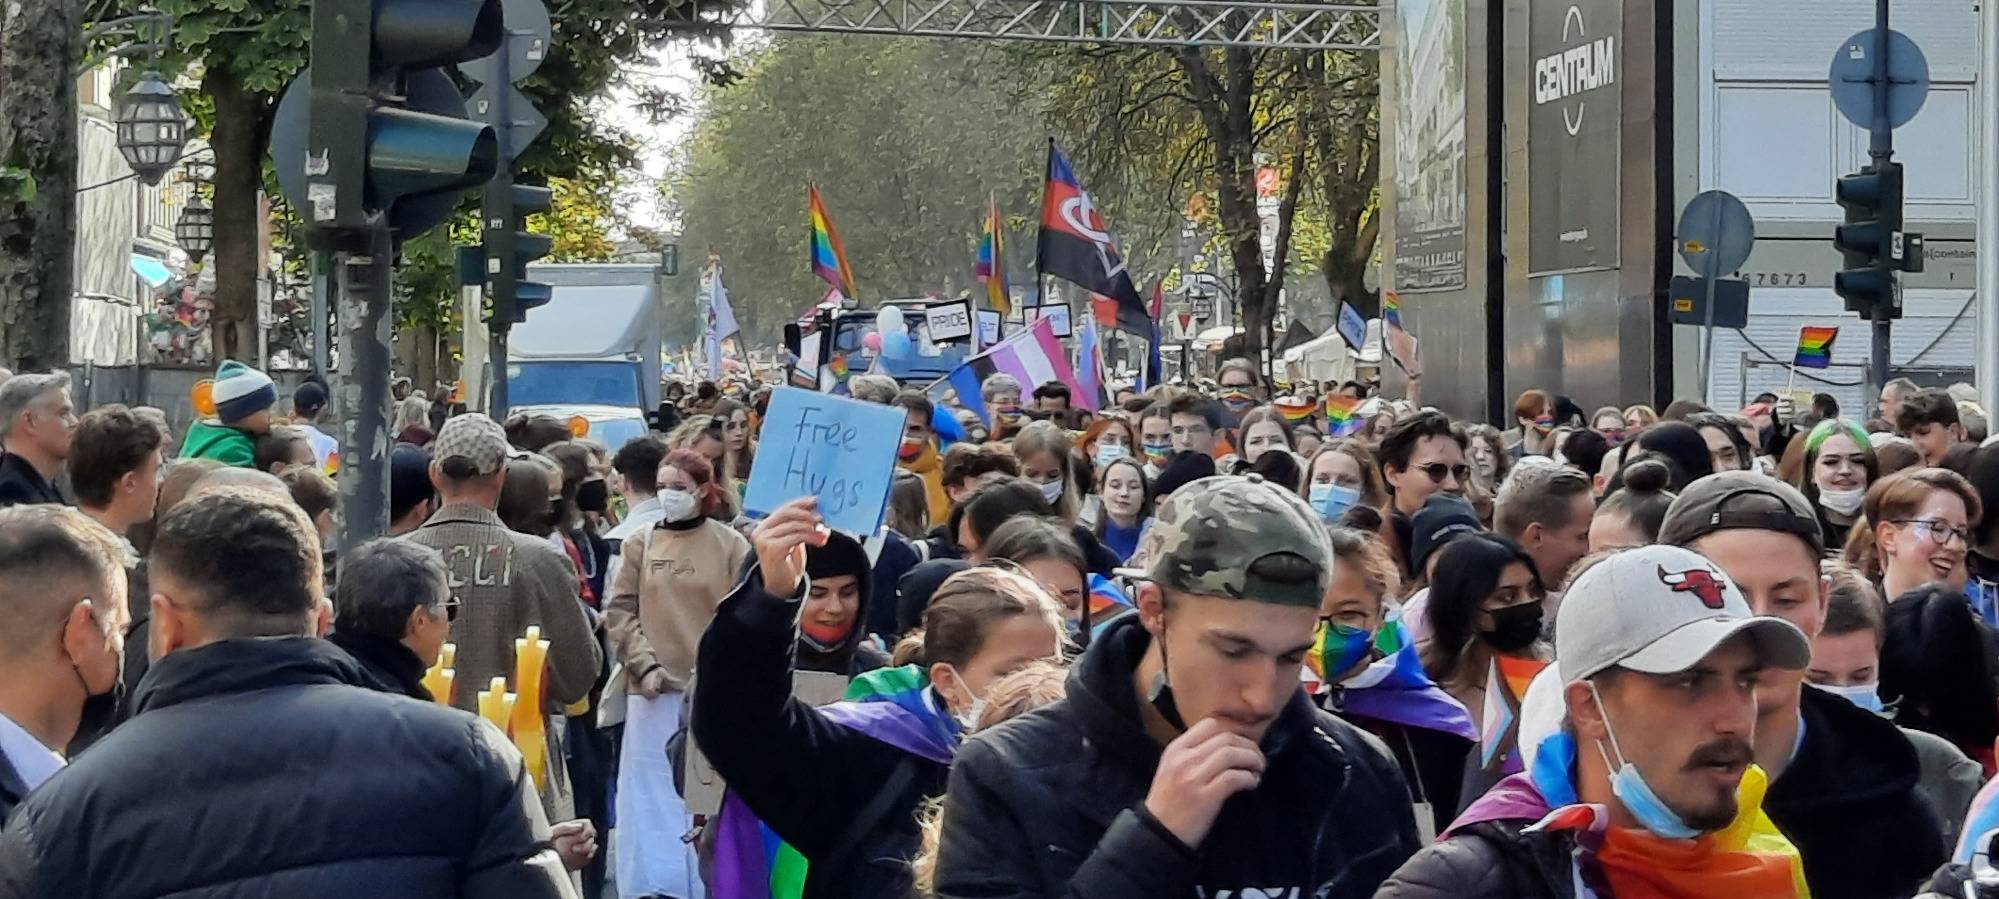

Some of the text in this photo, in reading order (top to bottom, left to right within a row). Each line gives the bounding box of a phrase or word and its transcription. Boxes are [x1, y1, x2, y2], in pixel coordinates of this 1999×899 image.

[1536, 35, 1615, 105] CENTRUM
[931, 311, 968, 331] PRIDE
[794, 406, 857, 452] Free
[784, 445, 864, 515] Hugs
